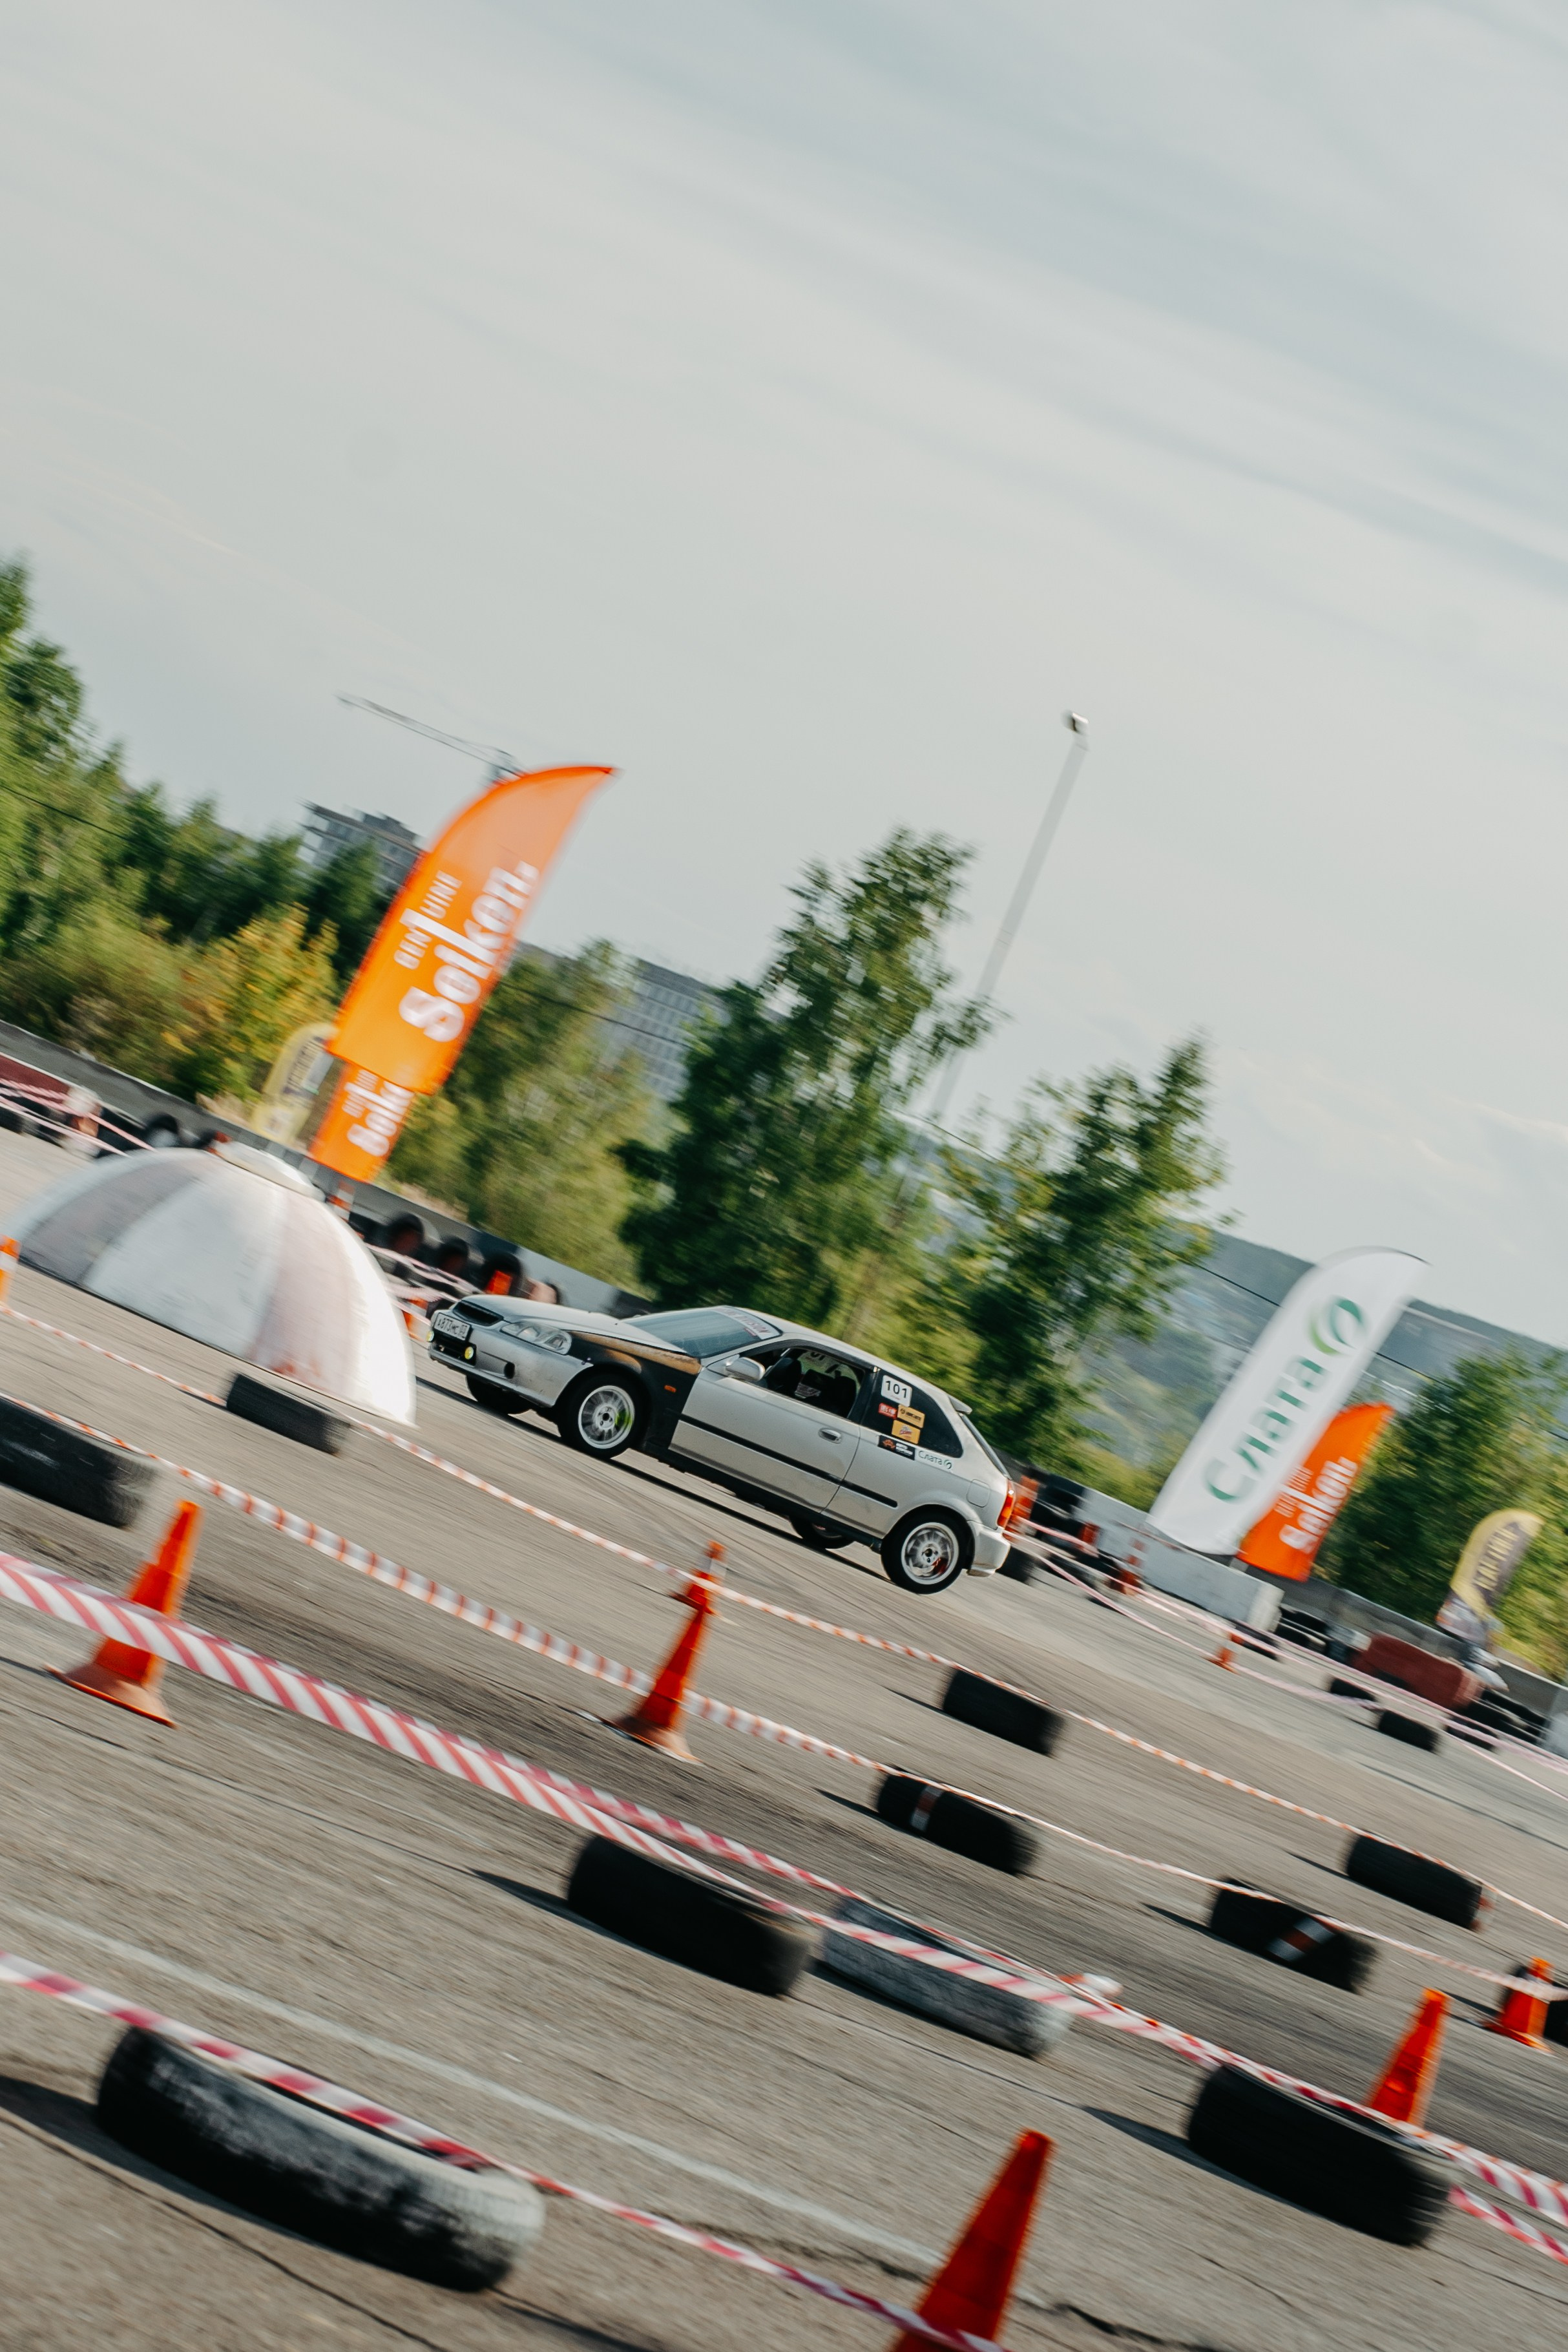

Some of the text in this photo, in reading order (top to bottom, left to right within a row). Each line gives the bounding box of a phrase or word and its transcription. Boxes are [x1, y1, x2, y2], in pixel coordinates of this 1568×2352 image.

[885, 1380, 908, 1399] 101
[1202, 1356, 1330, 1503] Слата
[918, 1450, 943, 1465] Слата
